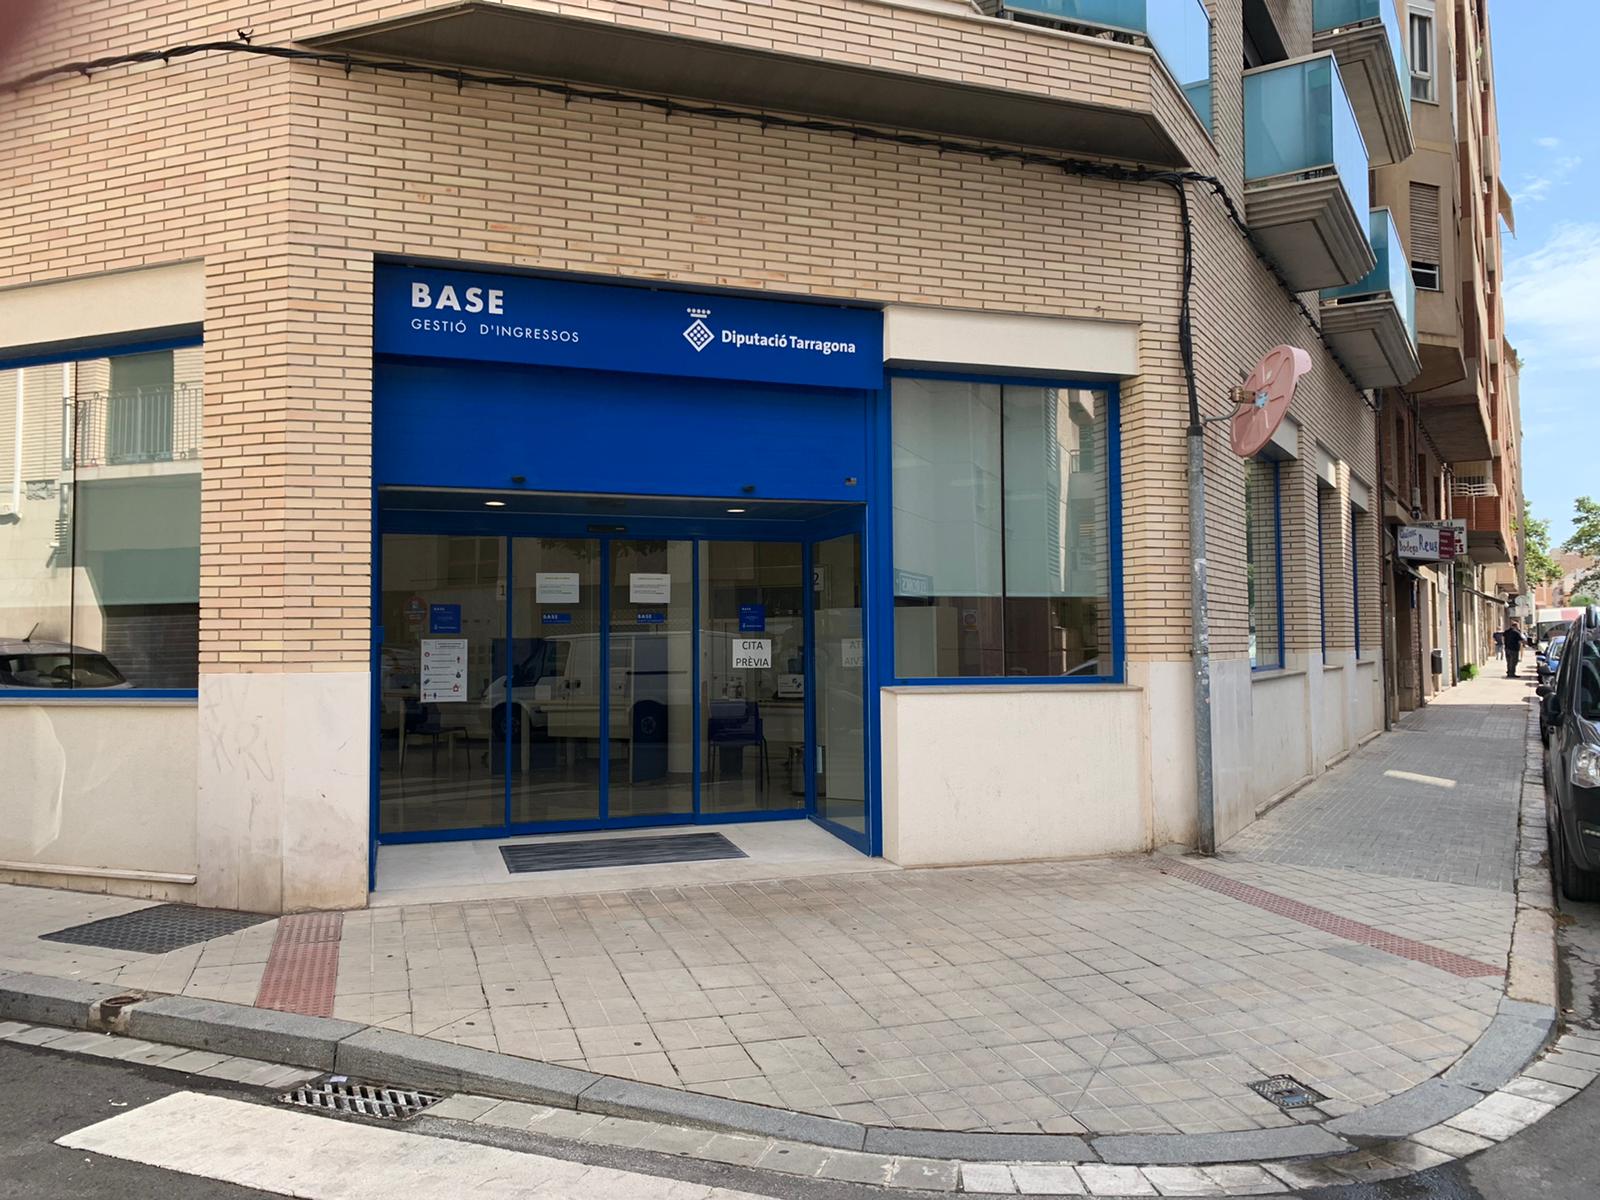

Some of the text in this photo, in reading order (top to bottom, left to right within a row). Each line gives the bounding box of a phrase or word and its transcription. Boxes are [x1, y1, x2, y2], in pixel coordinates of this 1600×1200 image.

[411, 282, 504, 315] BASE
[411, 318, 580, 343] GESTIÓ D'INGRESSOS
[721, 329, 856, 355] Diputació Tarragona
[1418, 533, 1438, 553] Reus
[742, 641, 764, 650] CITA
[735, 656, 770, 667] PRÈVIA
